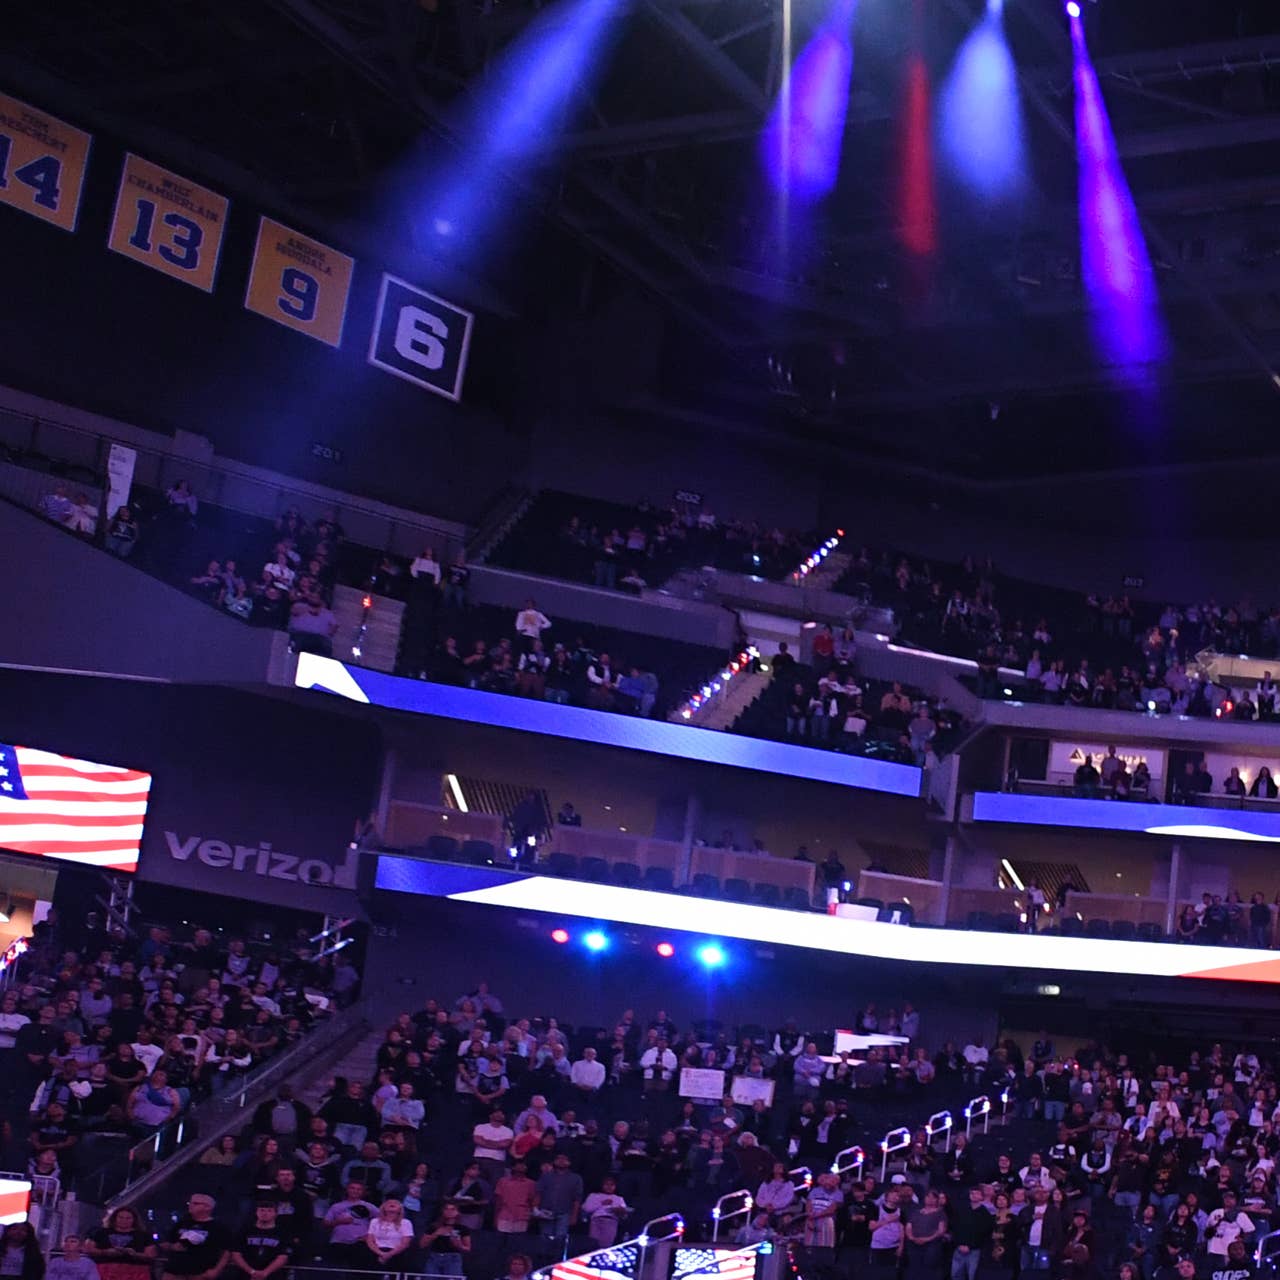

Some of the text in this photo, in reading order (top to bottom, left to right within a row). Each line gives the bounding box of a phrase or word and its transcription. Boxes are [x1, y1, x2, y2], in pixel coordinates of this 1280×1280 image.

[129, 199, 205, 271] 13
[277, 266, 319, 322] 9
[394, 304, 448, 370] 6
